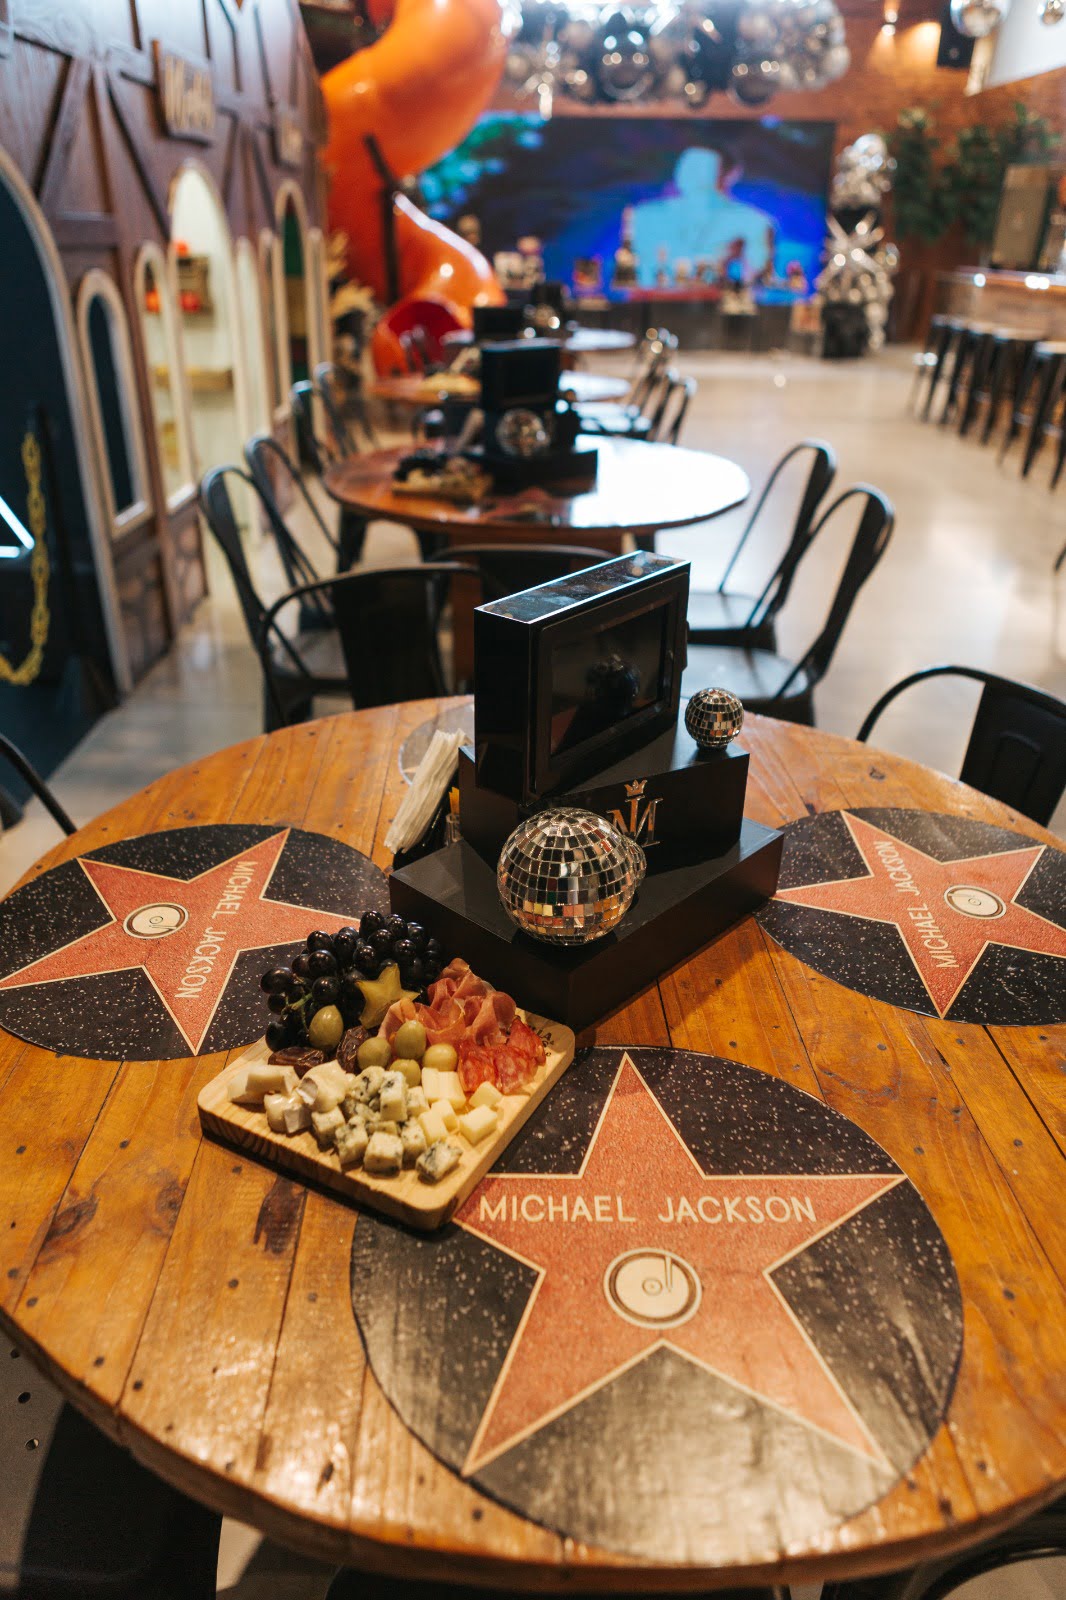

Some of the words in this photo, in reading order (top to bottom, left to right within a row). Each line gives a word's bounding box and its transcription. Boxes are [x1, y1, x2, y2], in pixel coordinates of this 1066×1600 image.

[211, 860, 259, 920] MICHAEL
[873, 840, 920, 896] JACKSON
[174, 926, 227, 998] JACKSON
[906, 902, 960, 969] MICHAEL
[478, 1193, 637, 1224] MICHAEL
[657, 1194, 818, 1225] JACKSON
